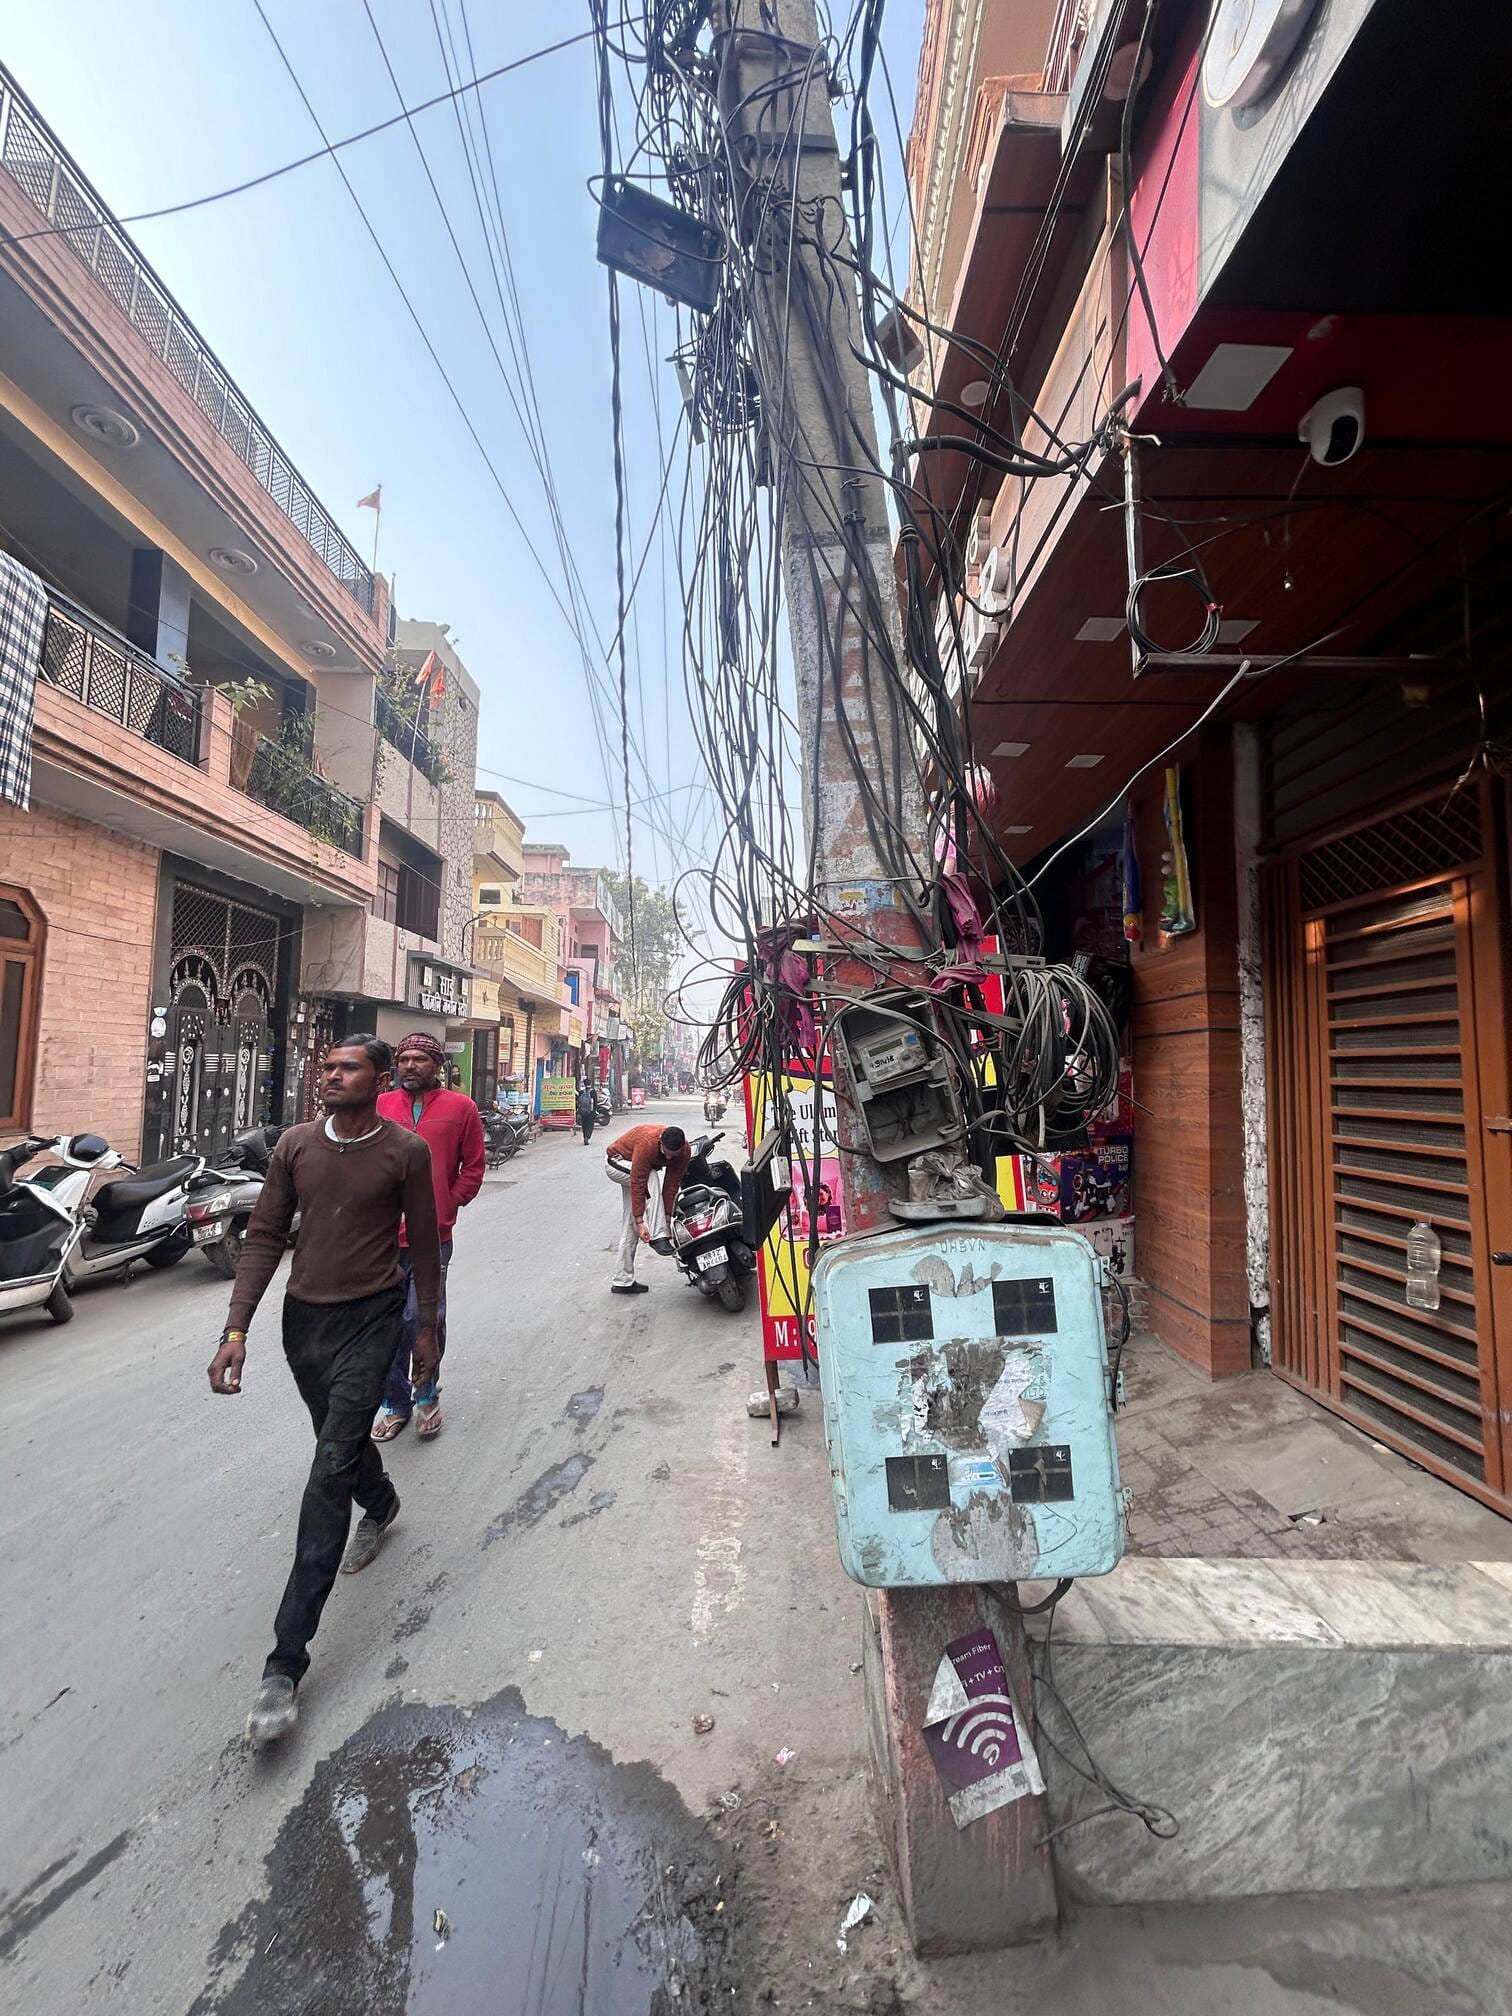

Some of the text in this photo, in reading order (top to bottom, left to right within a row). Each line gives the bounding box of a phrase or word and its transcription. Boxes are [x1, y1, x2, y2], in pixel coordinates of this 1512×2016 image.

[1099, 1146, 1129, 1155] TURBO
[1098, 1154, 1129, 1163] POLICE
[971, 1644, 991, 1655] Fiber
[974, 1670, 986, 1681] TV
